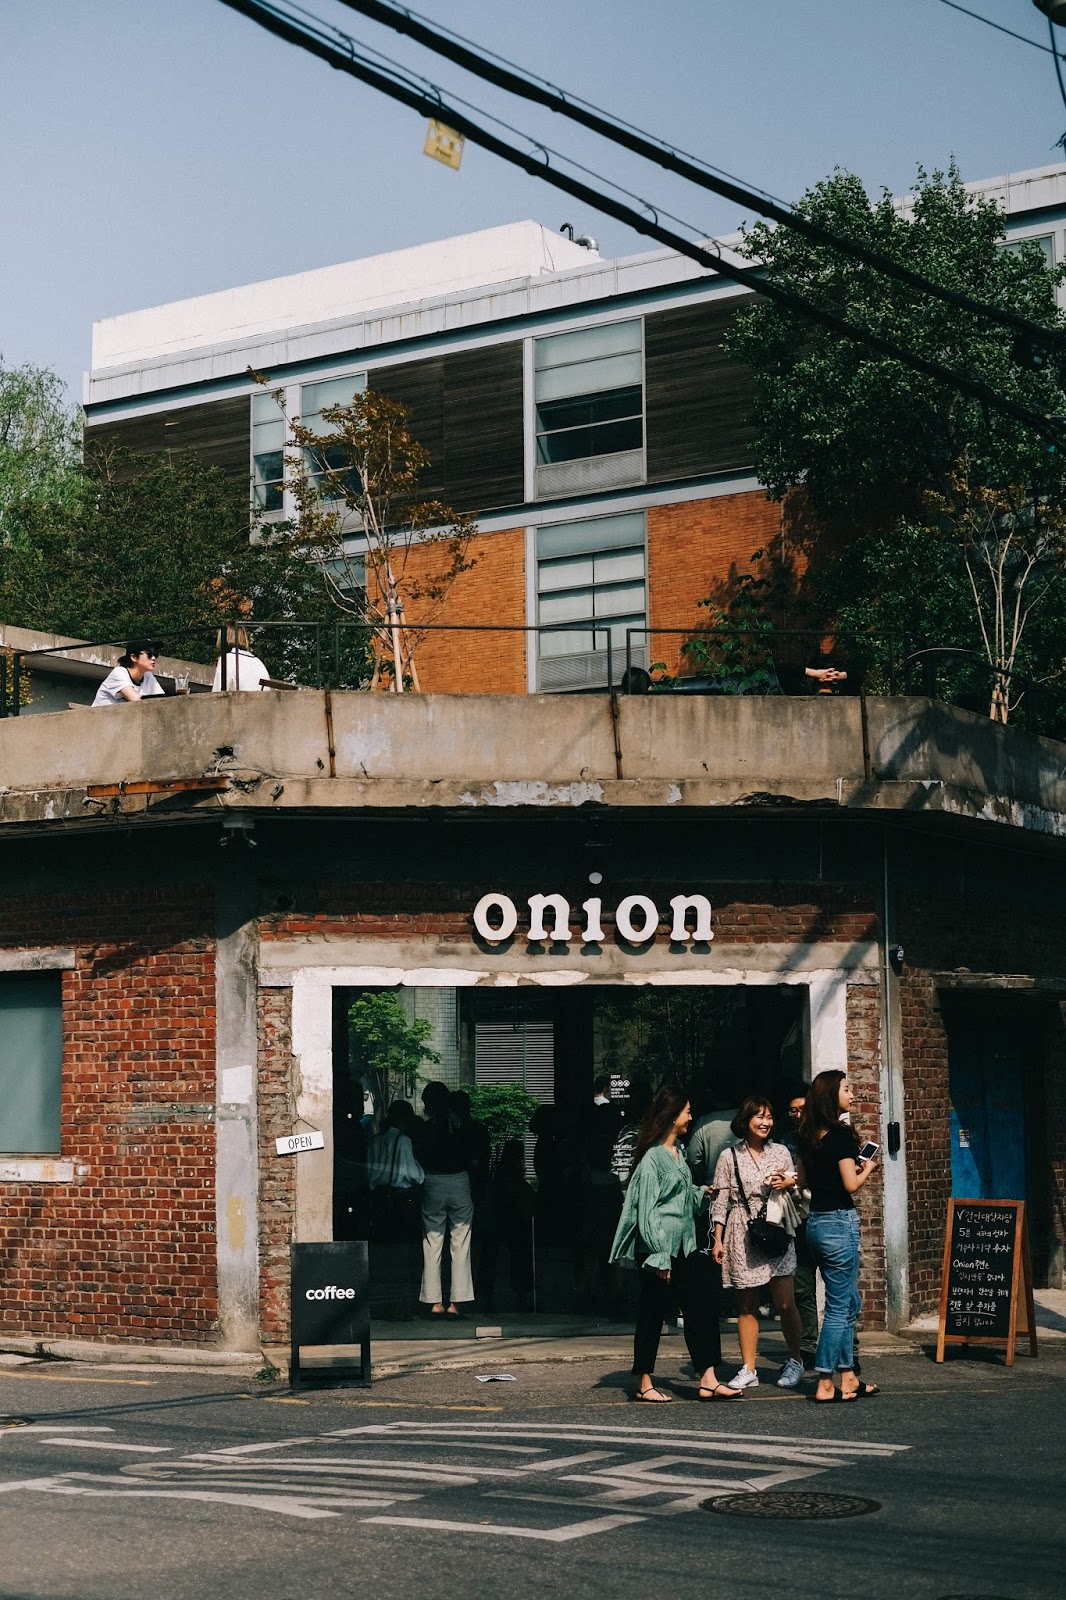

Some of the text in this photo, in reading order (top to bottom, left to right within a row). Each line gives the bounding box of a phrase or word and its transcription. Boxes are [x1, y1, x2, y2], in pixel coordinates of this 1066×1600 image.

[473, 872, 714, 942] onion
[288, 1136, 312, 1149] OPEN
[959, 1227, 971, 1238] 5분
[992, 1243, 1011, 1253] 주차
[305, 1286, 356, 1300] coffee
[966, 1300, 974, 1311] 앞
[976, 1301, 997, 1313] 주차를
[955, 1315, 970, 1327] 금지
